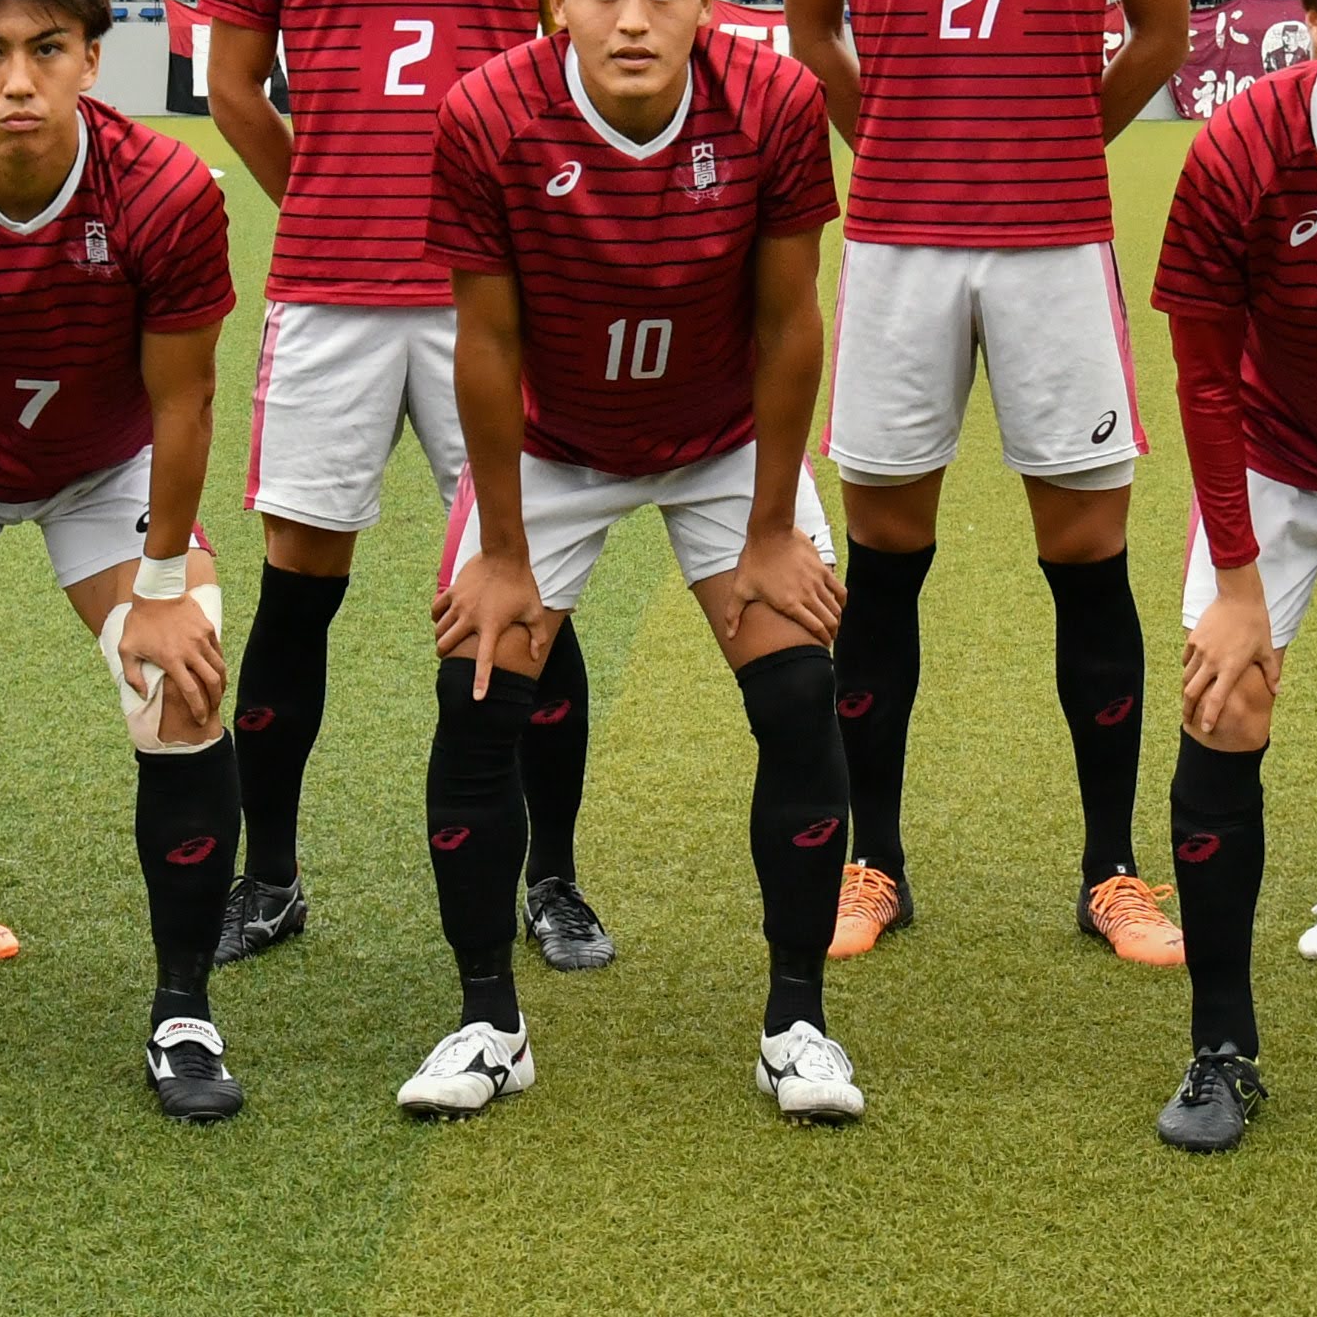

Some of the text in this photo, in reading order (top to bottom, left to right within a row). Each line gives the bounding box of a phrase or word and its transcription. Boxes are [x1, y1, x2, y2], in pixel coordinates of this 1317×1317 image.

[383, 19, 435, 96] 2
[604, 319, 672, 381] 10
[14, 379, 61, 430] 7
